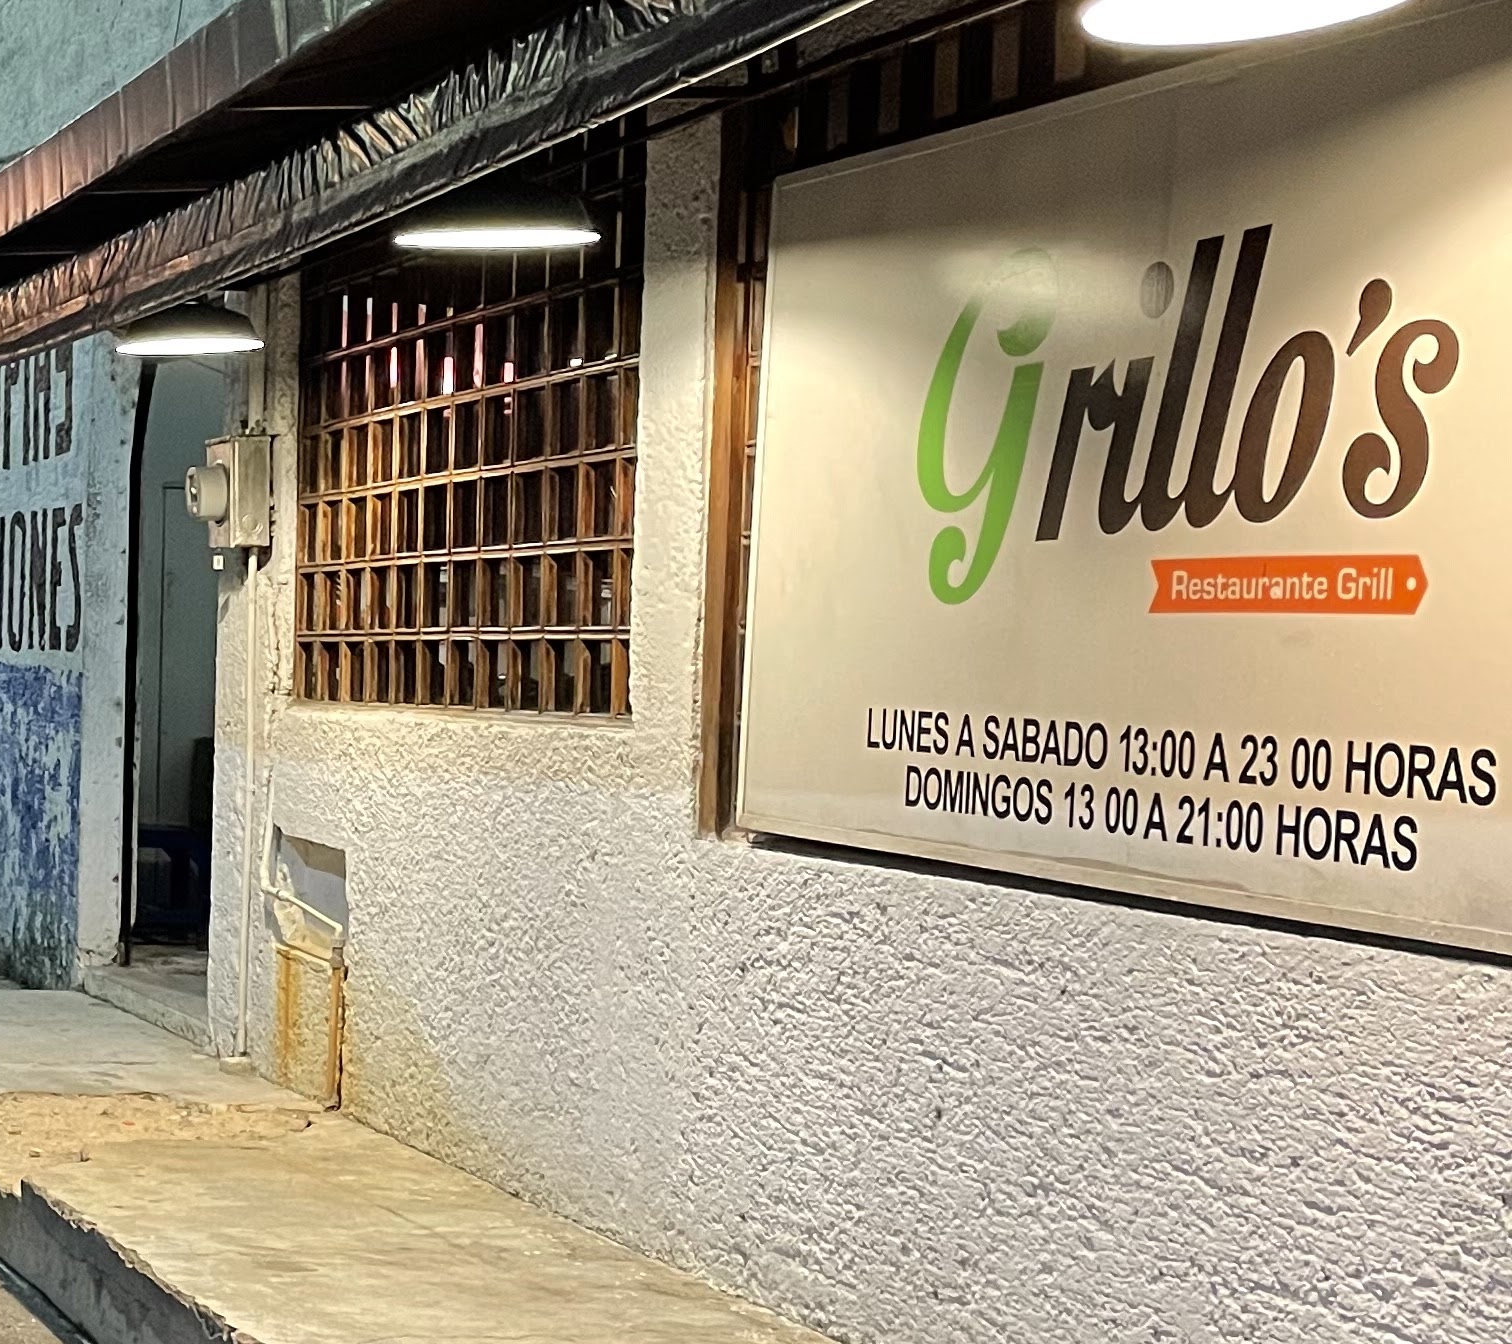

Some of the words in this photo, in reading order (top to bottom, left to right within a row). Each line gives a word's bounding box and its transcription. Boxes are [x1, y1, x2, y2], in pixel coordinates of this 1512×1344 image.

[1171, 569, 1328, 600] Restaurante
[1338, 567, 1394, 600] Grill
[866, 707, 950, 756] LUNES
[955, 713, 976, 758] A
[982, 714, 1109, 770] SABADO
[1119, 724, 1196, 780] 13:00
[1203, 732, 1231, 783] A
[1345, 740, 1498, 807] HORAS
[904, 764, 1054, 825] DOMINGOS
[1143, 792, 1168, 842] A
[1176, 798, 1265, 854] 21:00
[1276, 804, 1419, 873] HORAS
